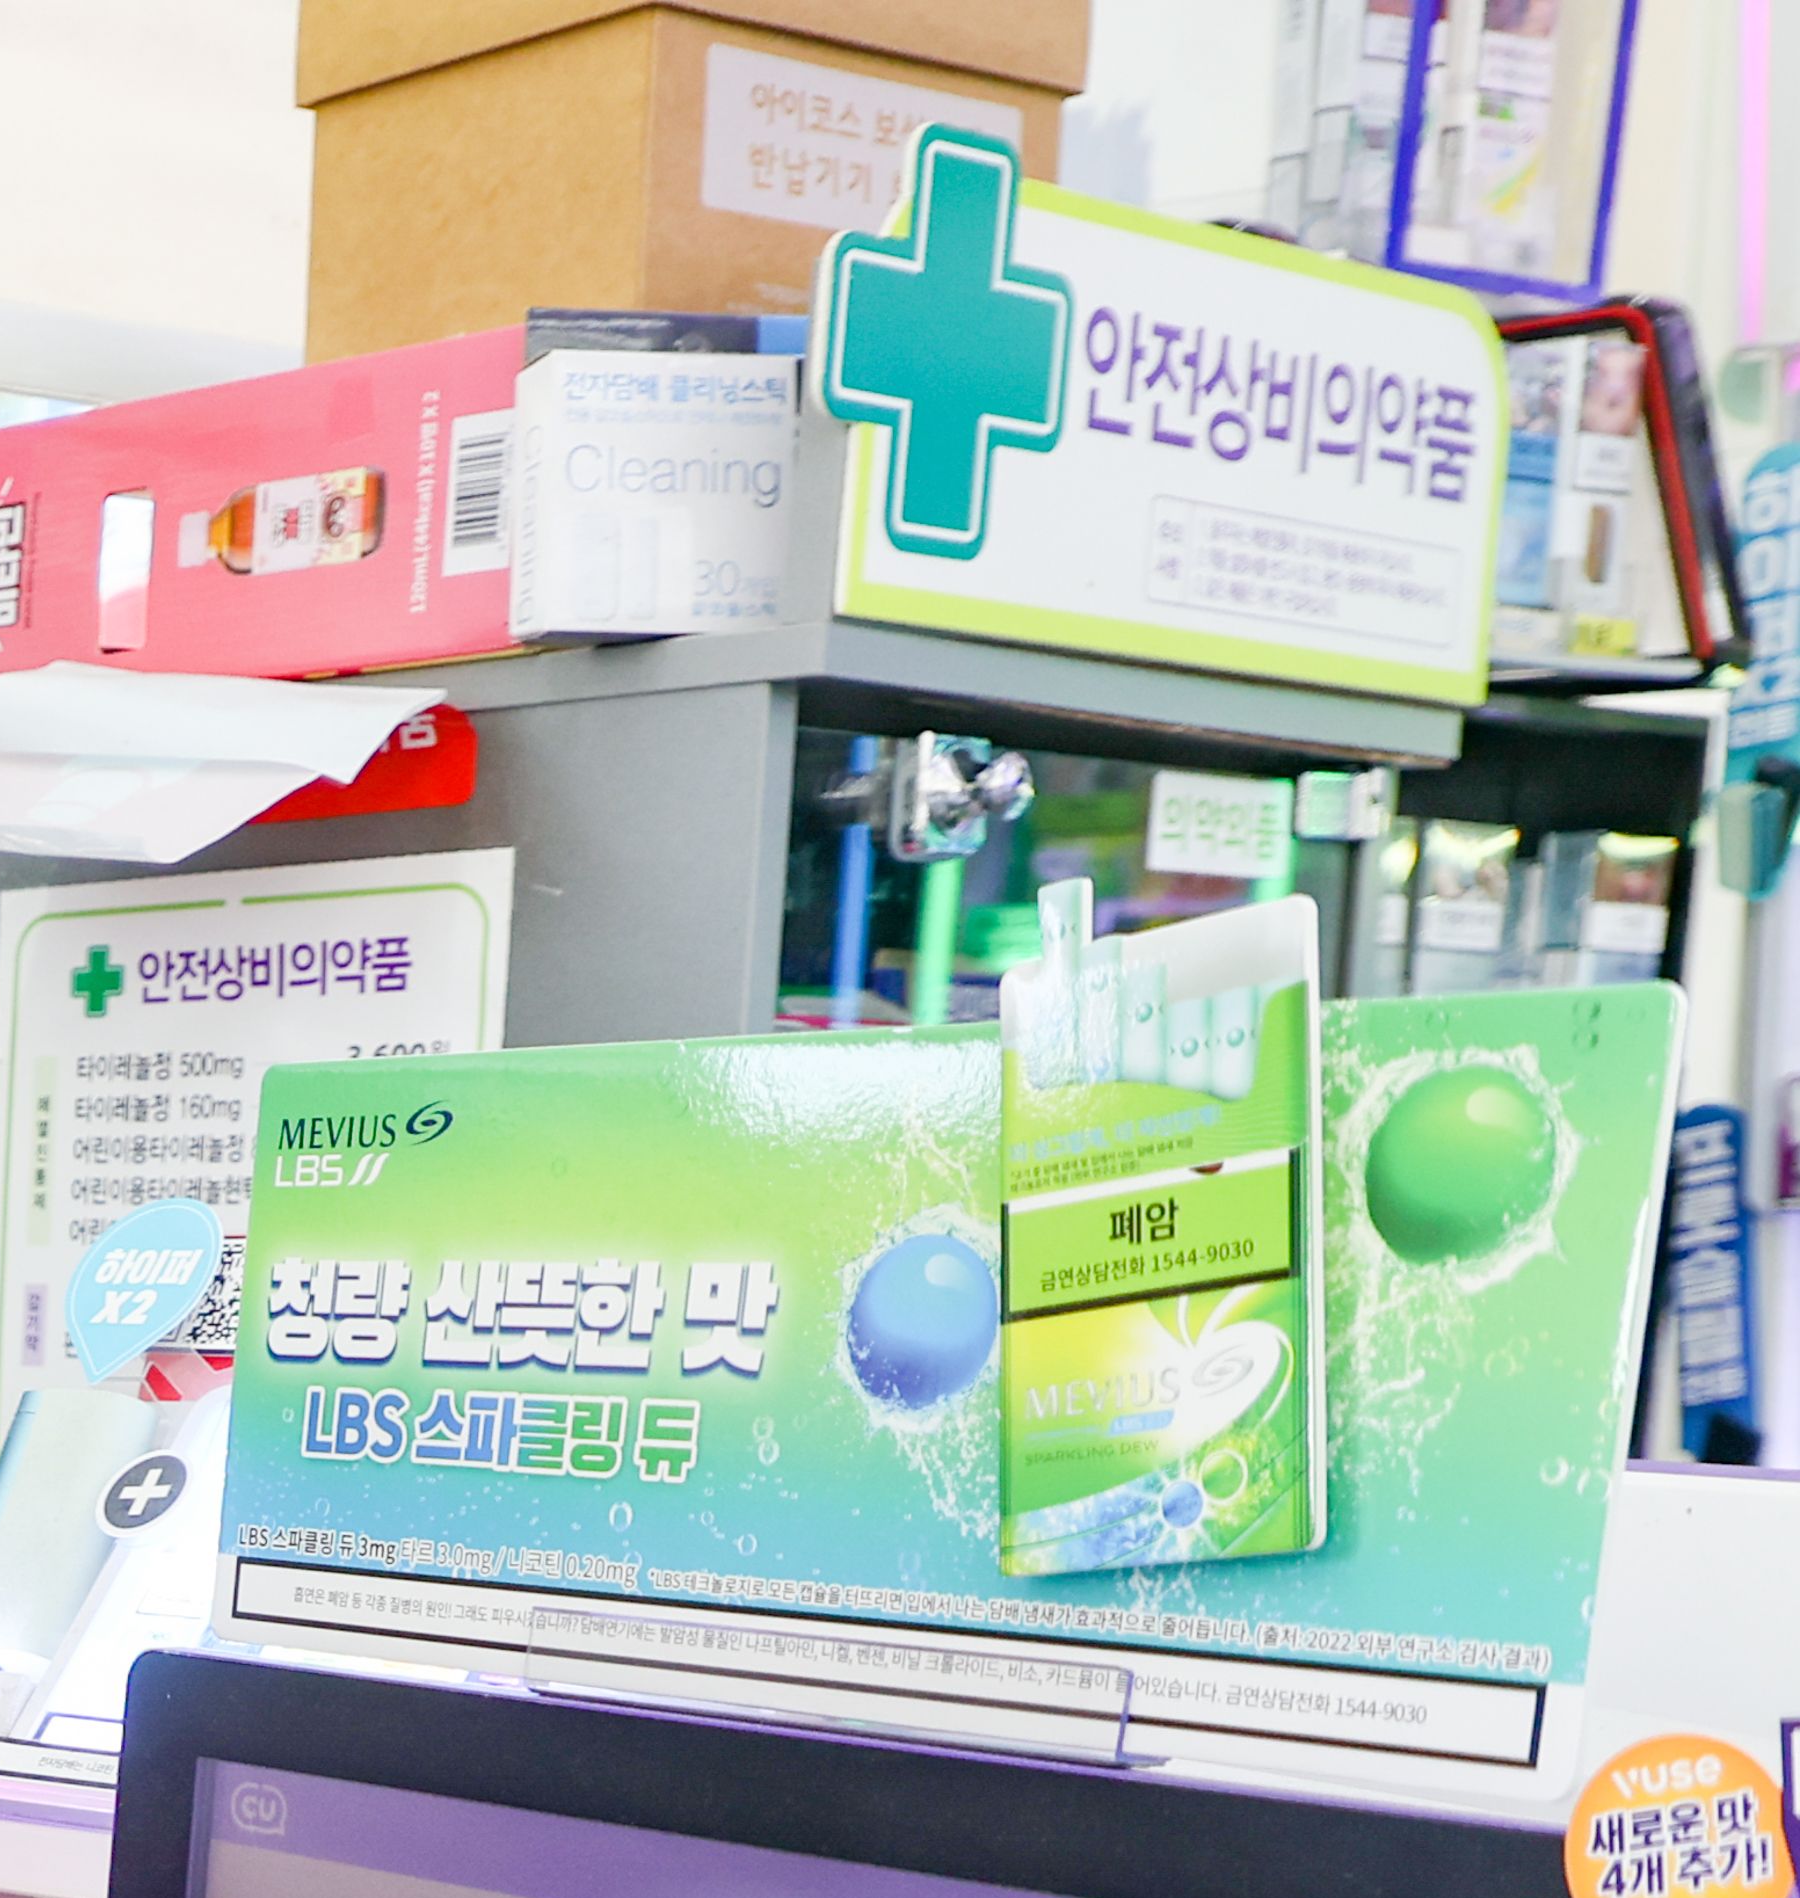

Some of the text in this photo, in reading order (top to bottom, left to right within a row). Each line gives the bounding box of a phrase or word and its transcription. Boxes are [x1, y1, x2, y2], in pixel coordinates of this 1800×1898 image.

[564, 372, 659, 401] 전자담배
[1087, 306, 1475, 501] 안전상비의약품
[566, 444, 781, 508] Cleaning
[137, 936, 413, 1004] 안전상비의약품
[179, 1051, 243, 1079] 500mg
[180, 1094, 242, 1121] 160mg
[278, 1114, 396, 1150] MEVIUS
[275, 1155, 343, 1186] LBS
[1110, 1197, 1178, 1246] 폐암
[94, 1246, 204, 1285] 하이퍼
[1039, 1239, 1255, 1293] 금연상담전화 1544-9030
[90, 1289, 154, 1325] X2
[268, 1258, 779, 1379] 청량 산뜻한 맛
[1024, 1367, 1180, 1421] MEVIUS
[304, 1388, 700, 1483] LBS 스파클링 듀
[238, 1524, 269, 1547] LBS
[272, 1528, 334, 1556] 스파클링
[339, 1533, 354, 1553] 듀
[359, 1536, 397, 1565] 3mg
[400, 1540, 434, 1564] 타르
[438, 1544, 492, 1576] 3.0mg
[508, 1550, 563, 1578] 니코틴
[566, 1557, 637, 1589] 0.20mg
[685, 1571, 765, 1598] 테크놀로지로
[768, 1579, 796, 1601] 모든
[799, 1581, 841, 1606] 캡슐을
[844, 1586, 902, 1611] 터뜨리면
[908, 1593, 951, 1615] 입에서
[954, 1597, 985, 1620] 나는
[989, 1600, 1020, 1623] 담배
[1023, 1602, 1071, 1626] 냄새가
[1074, 1608, 1156, 1635] 효과적으로
[1307, 1631, 1351, 1650] 2022
[1355, 1633, 1393, 1658] 외부
[1398, 1637, 1453, 1662] 연구소
[1458, 1644, 1498, 1668] 검사
[1502, 1647, 1552, 1674] 결과)
[293, 1586, 325, 1605] 흡연은
[327, 1590, 349, 1609] 폐암
[351, 1593, 362, 1611] 등
[365, 1594, 387, 1613] 각종
[390, 1597, 423, 1616] 질병의
[453, 1604, 488, 1622] 그래도
[580, 1617, 656, 1642] 담배연기에는
[659, 1625, 699, 1647] 발암성
[702, 1629, 743, 1651] 물질인
[892, 1649, 925, 1672] 비닐
[1046, 1667, 1110, 1691] 카드뮴이
[1226, 1685, 1330, 1714] 금연상담전화
[1336, 1698, 1427, 1726] 1544-9030
[1591, 1791, 1756, 1857] 새로운 맛
[1599, 1836, 1772, 1897] 4개 추가!
